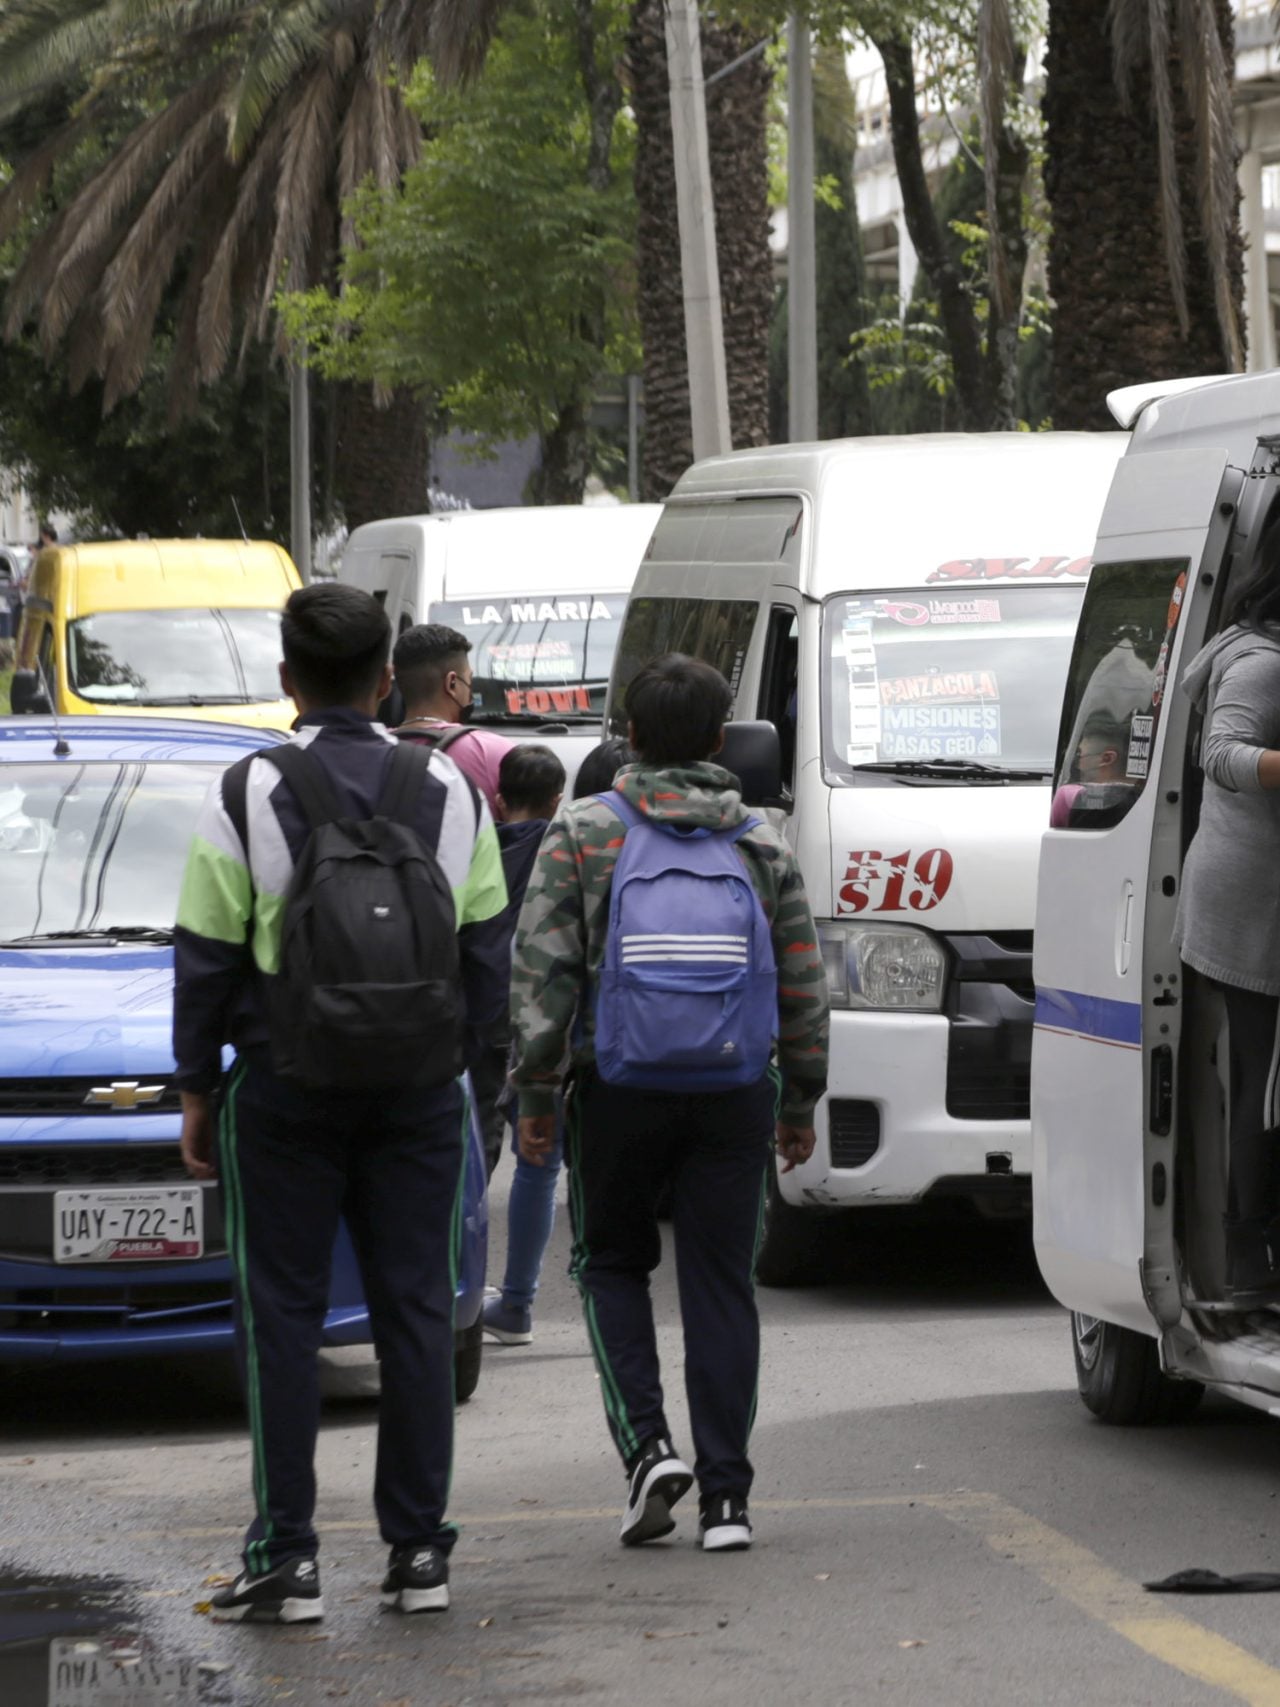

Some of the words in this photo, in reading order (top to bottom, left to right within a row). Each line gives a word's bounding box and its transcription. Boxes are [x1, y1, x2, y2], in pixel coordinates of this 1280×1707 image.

[462, 605, 503, 625] LA
[511, 601, 612, 623] MARIA
[880, 672, 996, 705] PANZACOLA
[505, 687, 592, 715] FOVI
[882, 707, 998, 730] MISIONES
[882, 731, 941, 755] CASAS
[945, 735, 976, 755] GEO
[61, 1206, 196, 1240] UAY-722-A
[119, 1241, 165, 1252] PUEBLA
